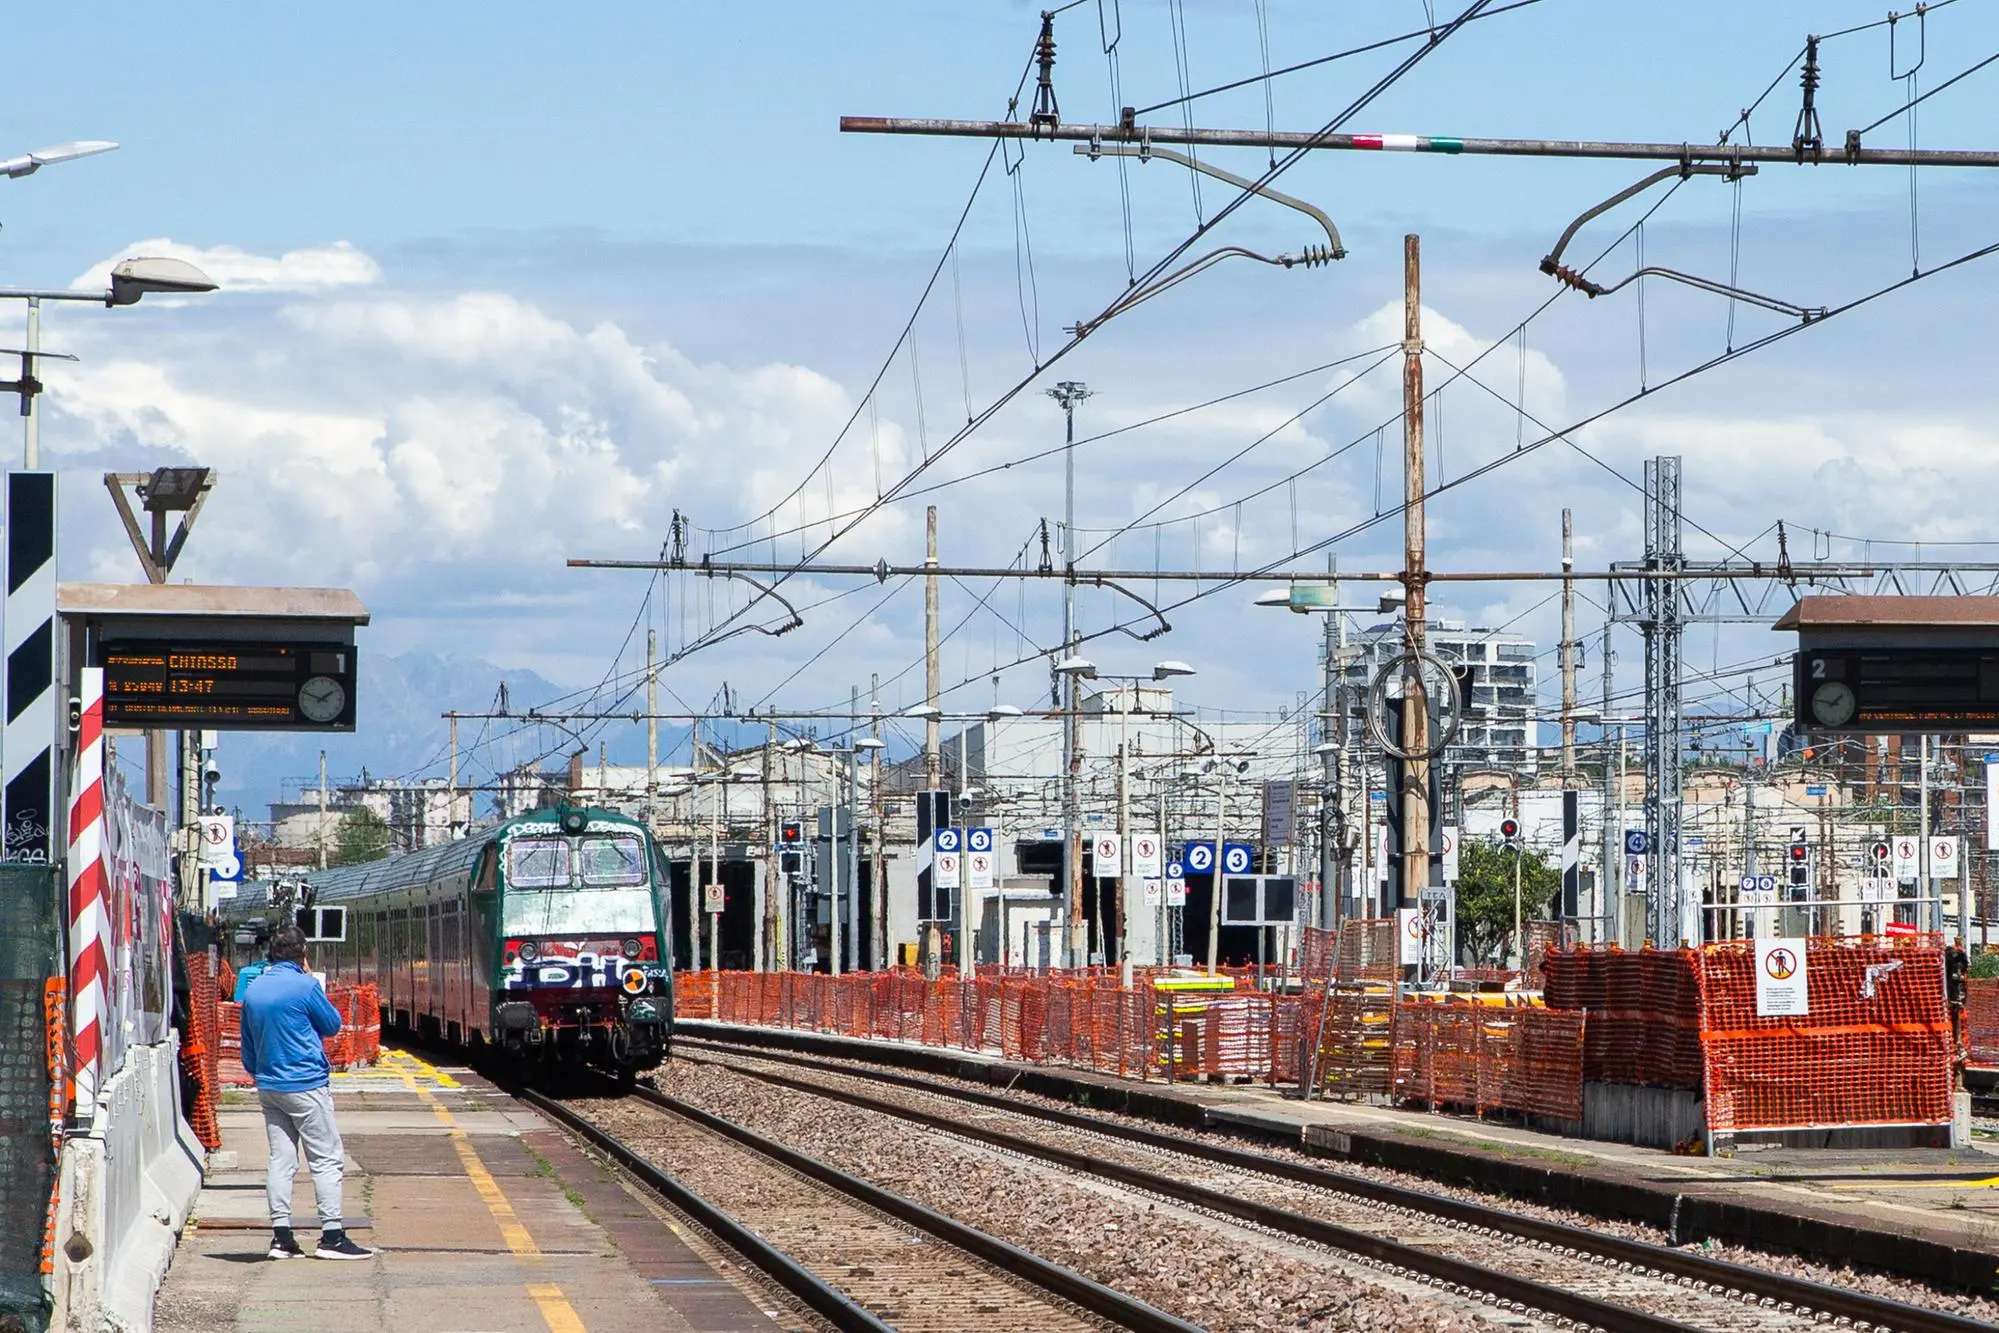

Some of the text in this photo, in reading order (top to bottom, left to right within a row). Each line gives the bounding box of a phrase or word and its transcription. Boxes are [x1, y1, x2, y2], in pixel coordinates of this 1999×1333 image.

[169, 655, 237, 670] CHIASSO
[336, 654, 346, 673] 1
[1812, 659, 1825, 678] 2
[171, 680, 214, 693] 13:47
[943, 834, 952, 846] 2
[975, 834, 985, 846] 3
[1632, 837, 1642, 848] 4
[1195, 852, 1206, 865] 2
[1232, 853, 1242, 867] 3
[1172, 866, 1178, 875] 5
